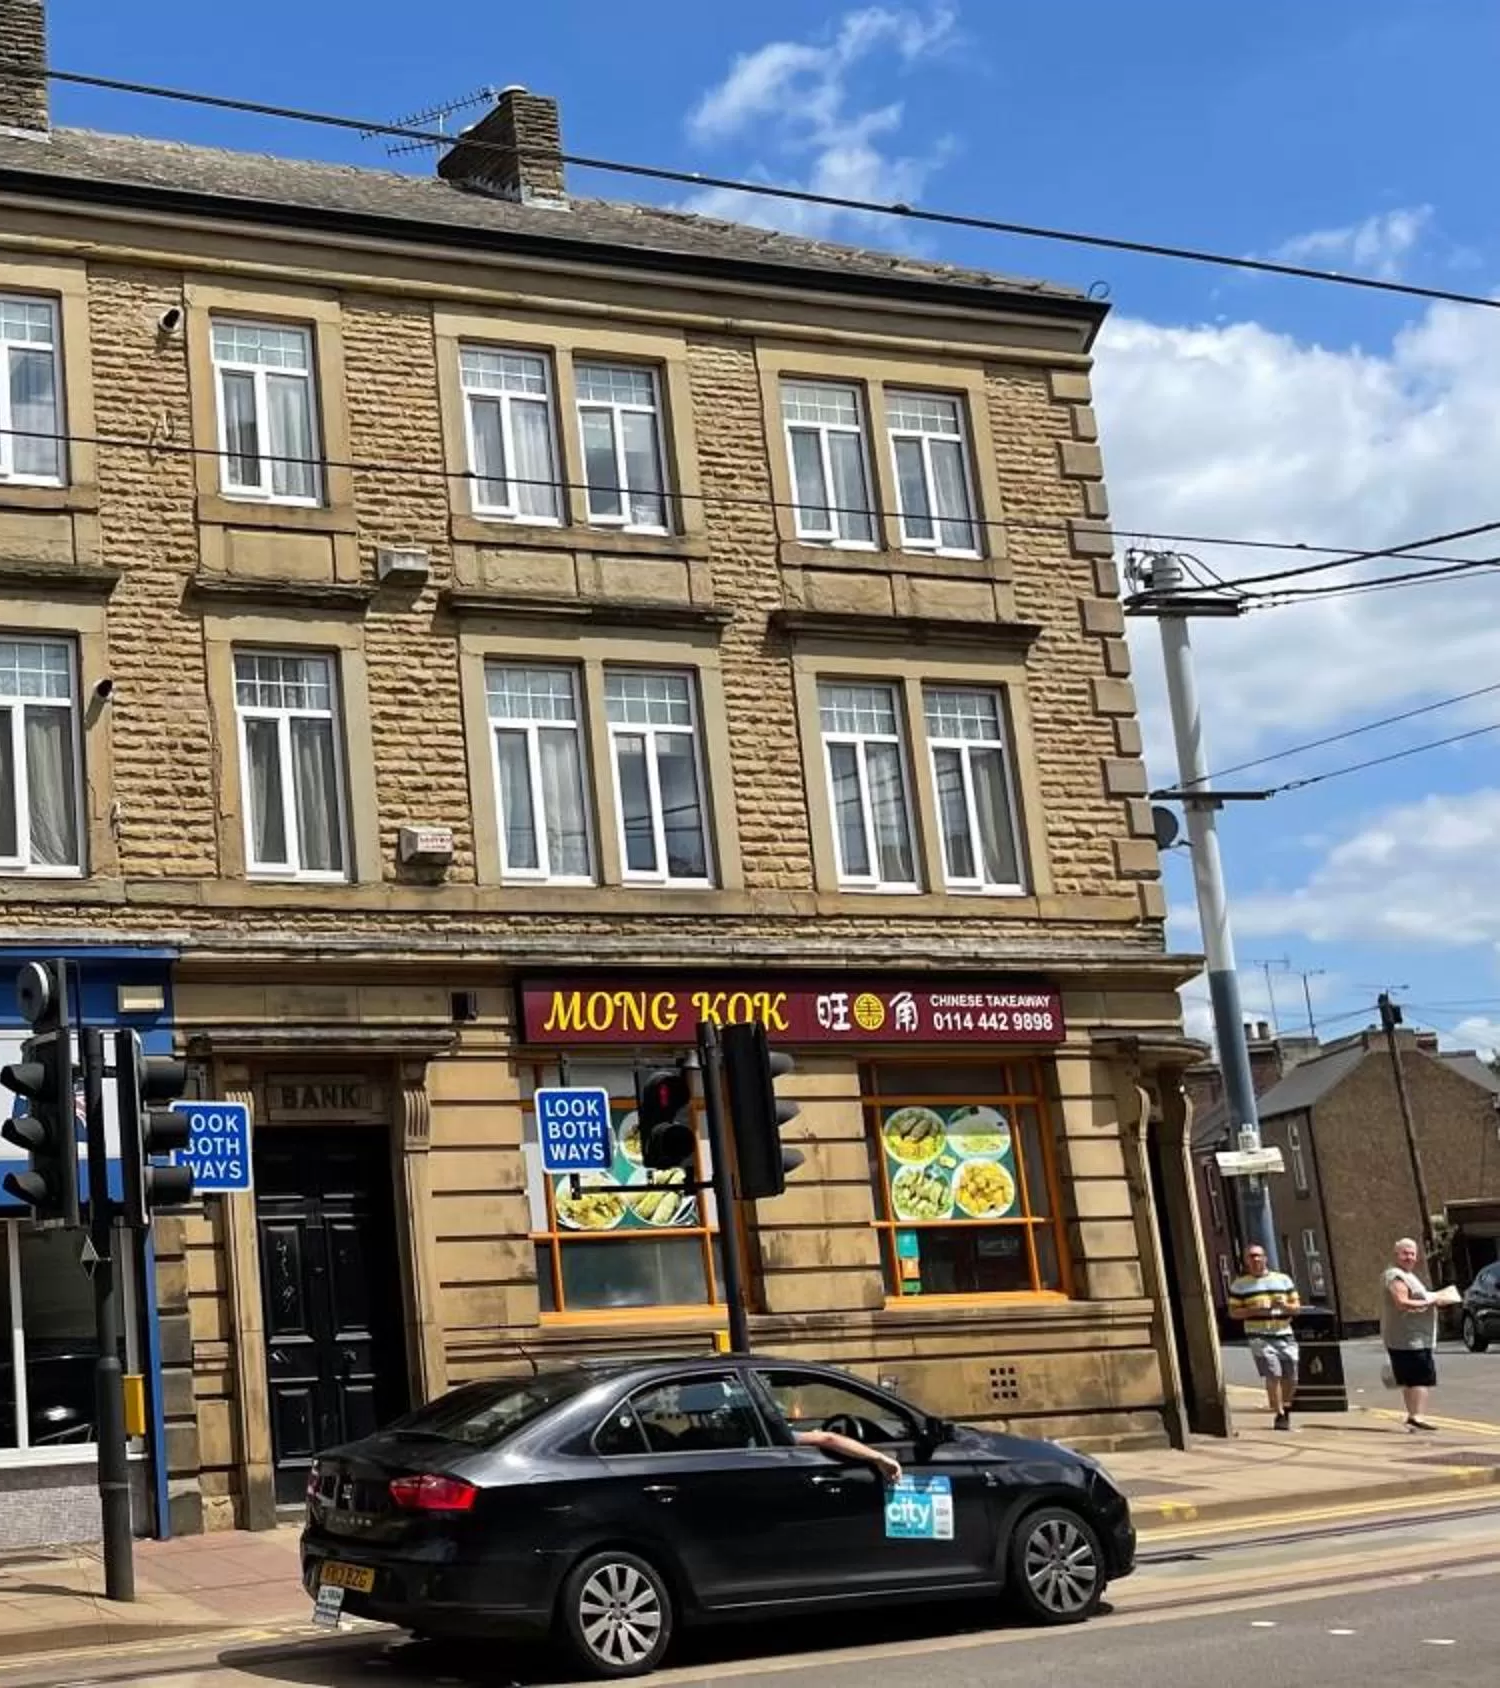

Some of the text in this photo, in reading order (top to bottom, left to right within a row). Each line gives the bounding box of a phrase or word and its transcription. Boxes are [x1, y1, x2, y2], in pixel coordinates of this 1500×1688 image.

[929, 994, 1050, 1008] CHINESE TAKEAWAY
[543, 991, 789, 1031] MONG KOK
[816, 991, 919, 1032] 旺 角
[932, 1012, 1054, 1031] 0114 442 9898
[281, 1084, 357, 1109] BANK
[545, 1099, 600, 1117] LOOK
[190, 1113, 239, 1133] OOK
[547, 1121, 602, 1139] BOTH
[549, 1142, 605, 1161] WAYS
[886, 1496, 931, 1529] city
